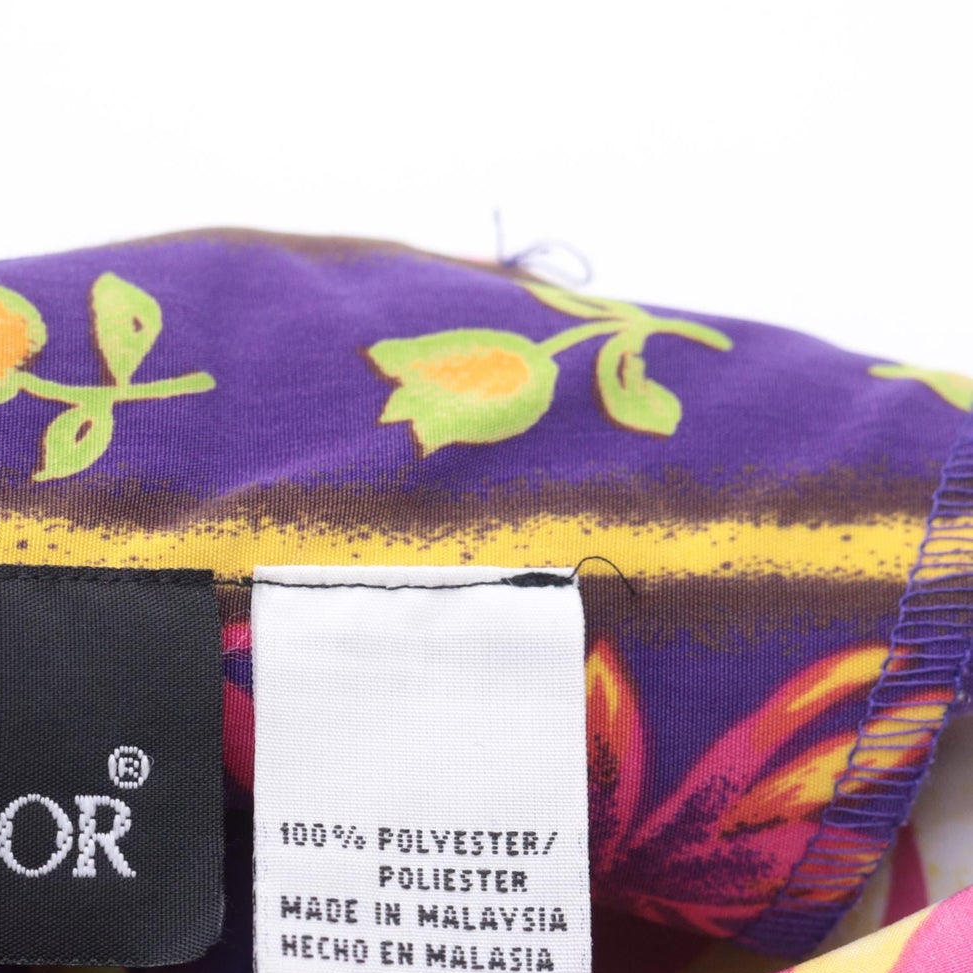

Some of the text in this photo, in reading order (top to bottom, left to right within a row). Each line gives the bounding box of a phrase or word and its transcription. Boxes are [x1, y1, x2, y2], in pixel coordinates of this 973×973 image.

[280, 822, 558, 855] 100% POLYESTER/
[379, 866, 528, 892] POLIESTER
[280, 895, 568, 932] MADE IN MALAYSIA
[281, 934, 554, 972] HECHO EN MALASIA
